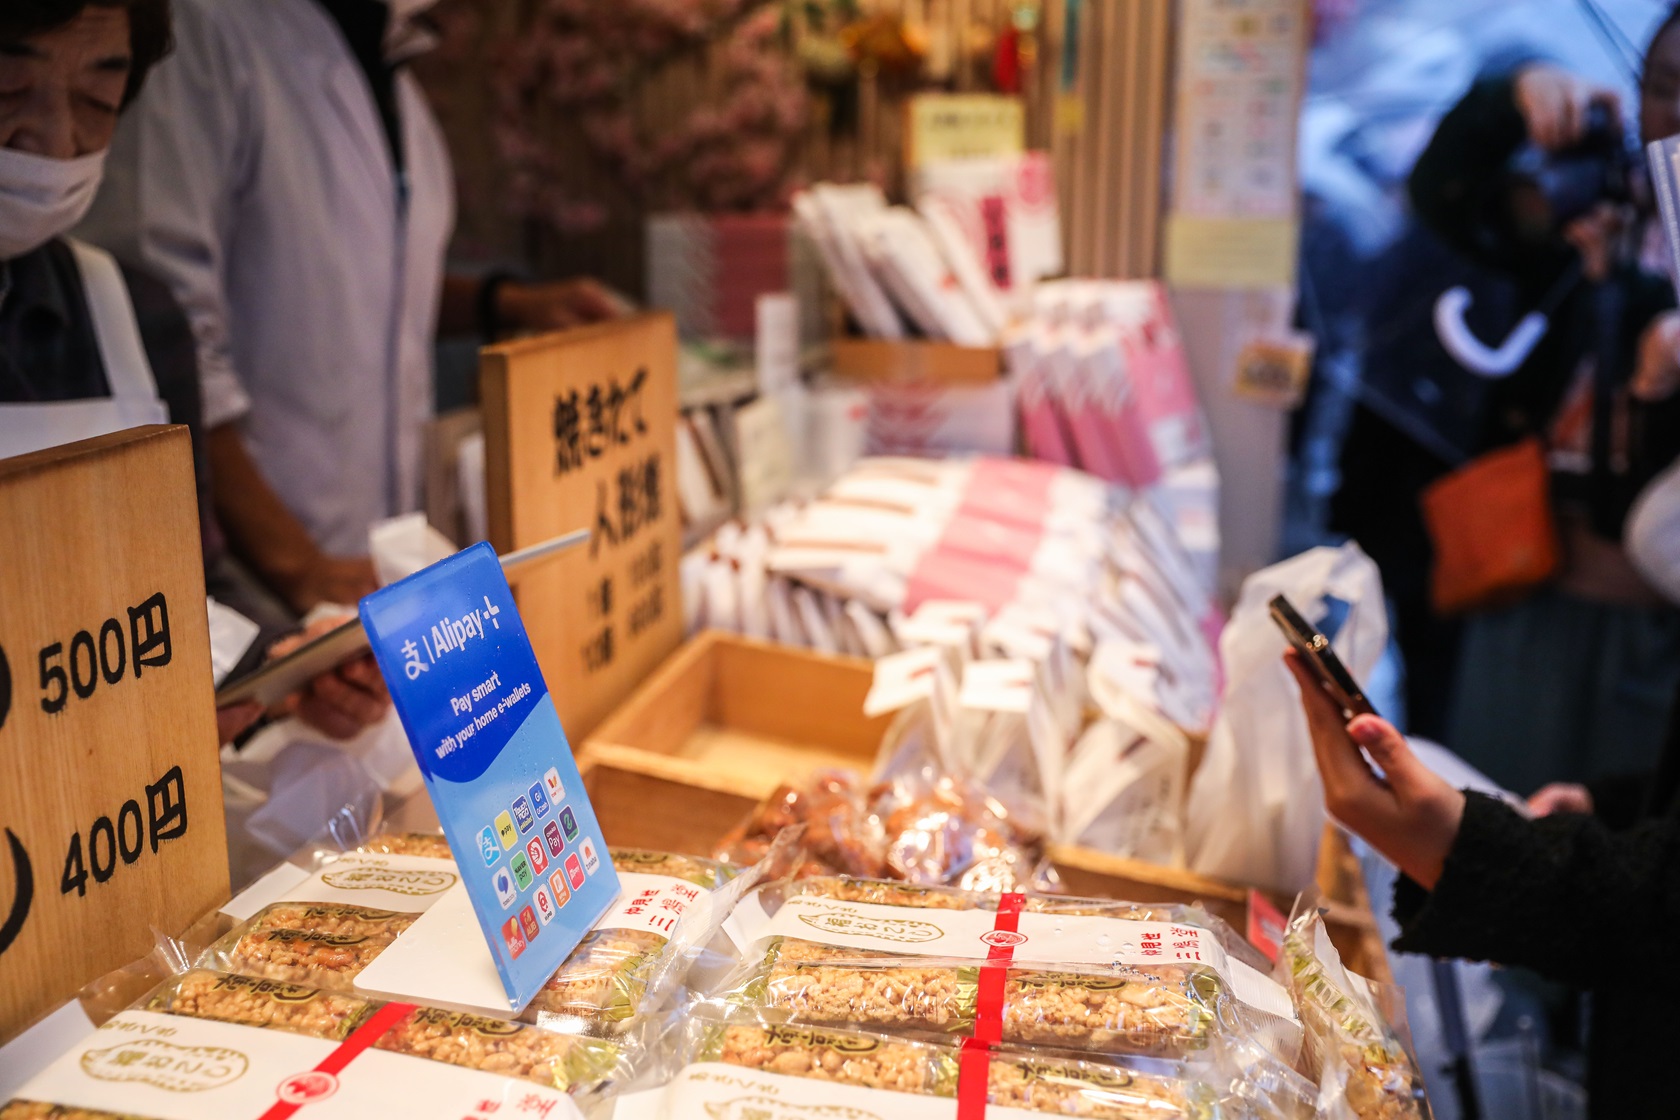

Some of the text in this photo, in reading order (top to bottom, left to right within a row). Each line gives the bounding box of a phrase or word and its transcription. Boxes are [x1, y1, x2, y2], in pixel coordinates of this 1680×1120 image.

[554, 367, 648, 479] 焼きたて
[38, 592, 171, 713] 500円
[451, 671, 501, 716] Pay smart
[435, 682, 531, 759] with your home e-wallets
[61, 766, 187, 896] 400円
[514, 801, 527, 816] Touch
[548, 835, 560, 850] Pay
[526, 922, 537, 935] AUB
[1141, 933, 1162, 956] 仲見世
